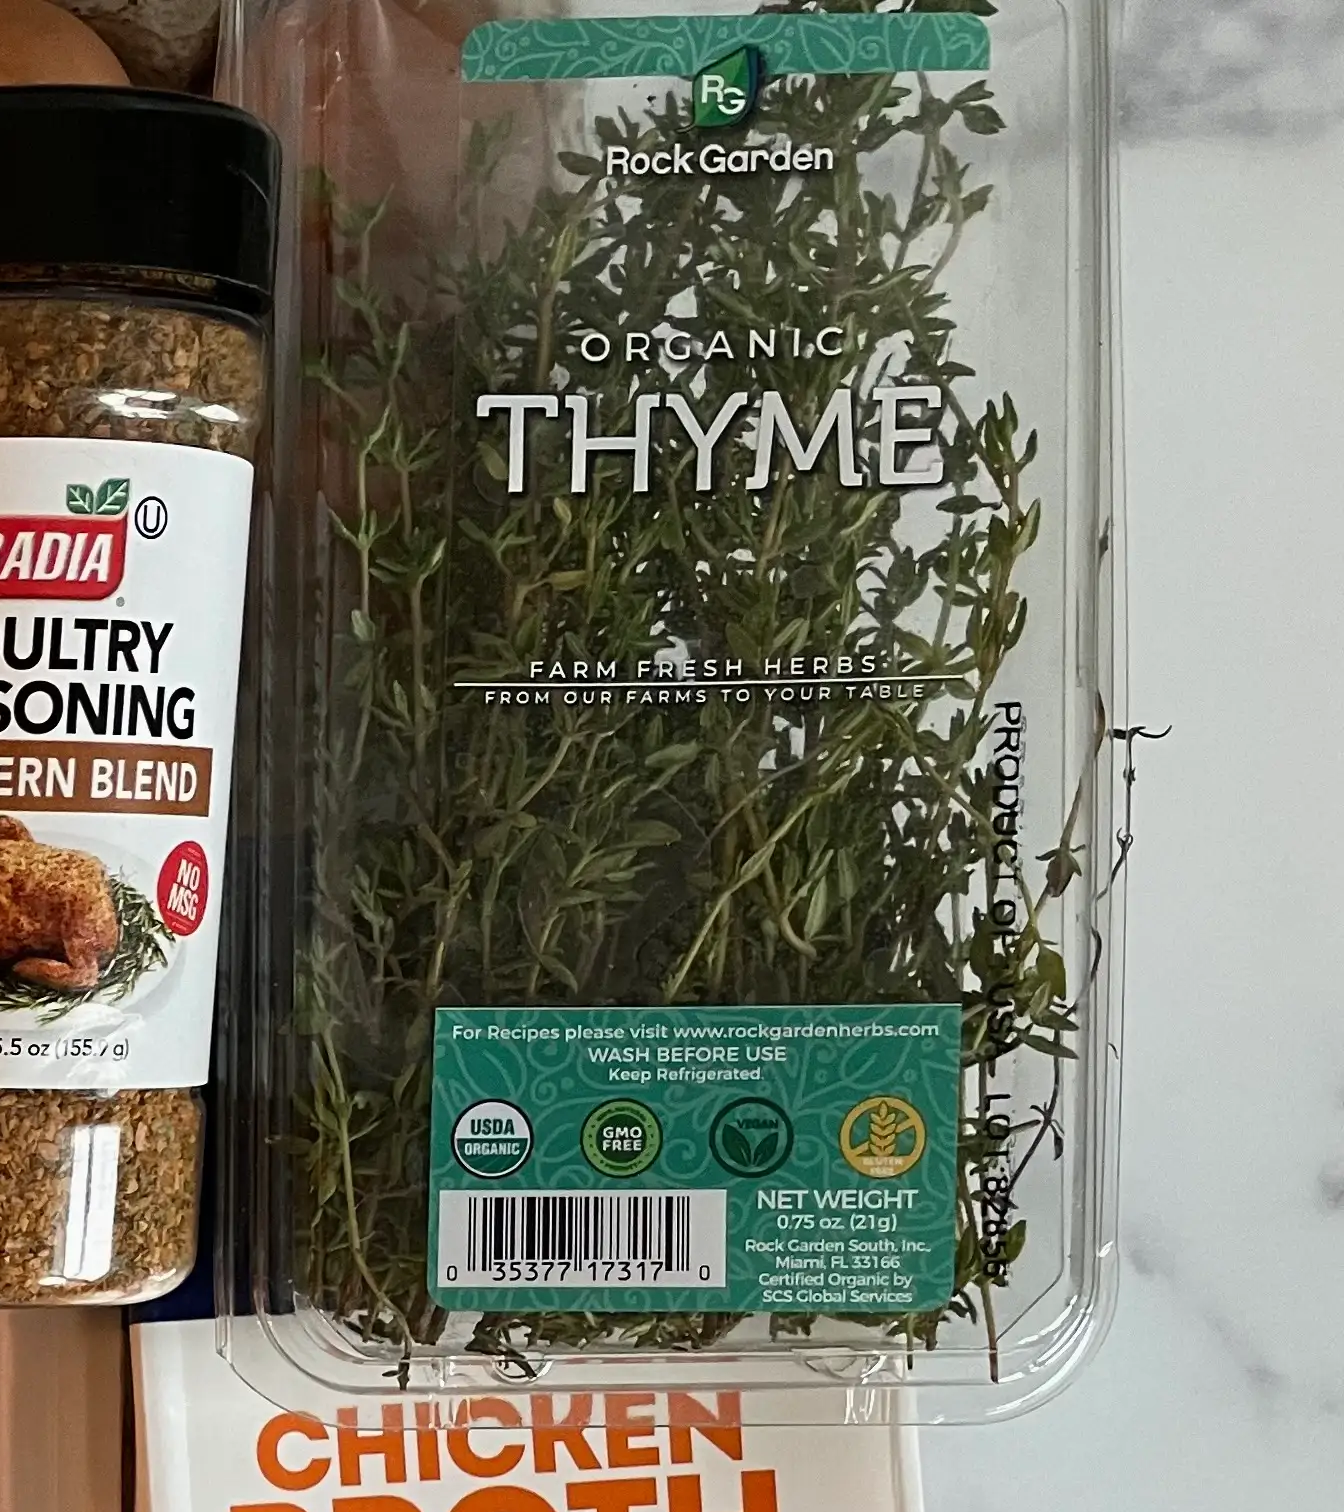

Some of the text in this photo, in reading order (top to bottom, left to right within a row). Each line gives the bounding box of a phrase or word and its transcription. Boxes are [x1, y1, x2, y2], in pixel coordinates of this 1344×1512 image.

[606, 140, 834, 176] Rock Garden
[580, 325, 844, 362] ORGANIC
[476, 386, 942, 493] THYME
[530, 655, 876, 680] FARM FRESH HERBS
[485, 684, 925, 705] FROM OUR FARMS TO YOUR TABLE
[91, 758, 197, 802] BLEND
[992, 701, 1022, 884] PRODUCT
[176, 859, 201, 891] NO
[167, 882, 199, 921] MSG
[452, 1022, 940, 1043] For Recipes please visit www.rockgardenherbs.com
[588, 1046, 787, 1063] WASH BEFORE USE
[608, 1067, 652, 1085] Keep
[470, 1118, 515, 1135] USDA
[602, 1126, 643, 1139] GMO
[464, 1142, 520, 1157] ORGANIC
[602, 1139, 643, 1152] FREE
[757, 1189, 919, 1210] NET WEIGHT
[776, 1213, 898, 1233] 0.75 (21g)
[745, 1239, 845, 1253] Rock Garden
[492, 1261, 664, 1282] 35377 17317
[852, 1255, 901, 1270] 33166
[758, 1272, 889, 1289] Certified Organic
[762, 1289, 913, 1304] SCS Global Services
[257, 1390, 742, 1491] CHICKEN
